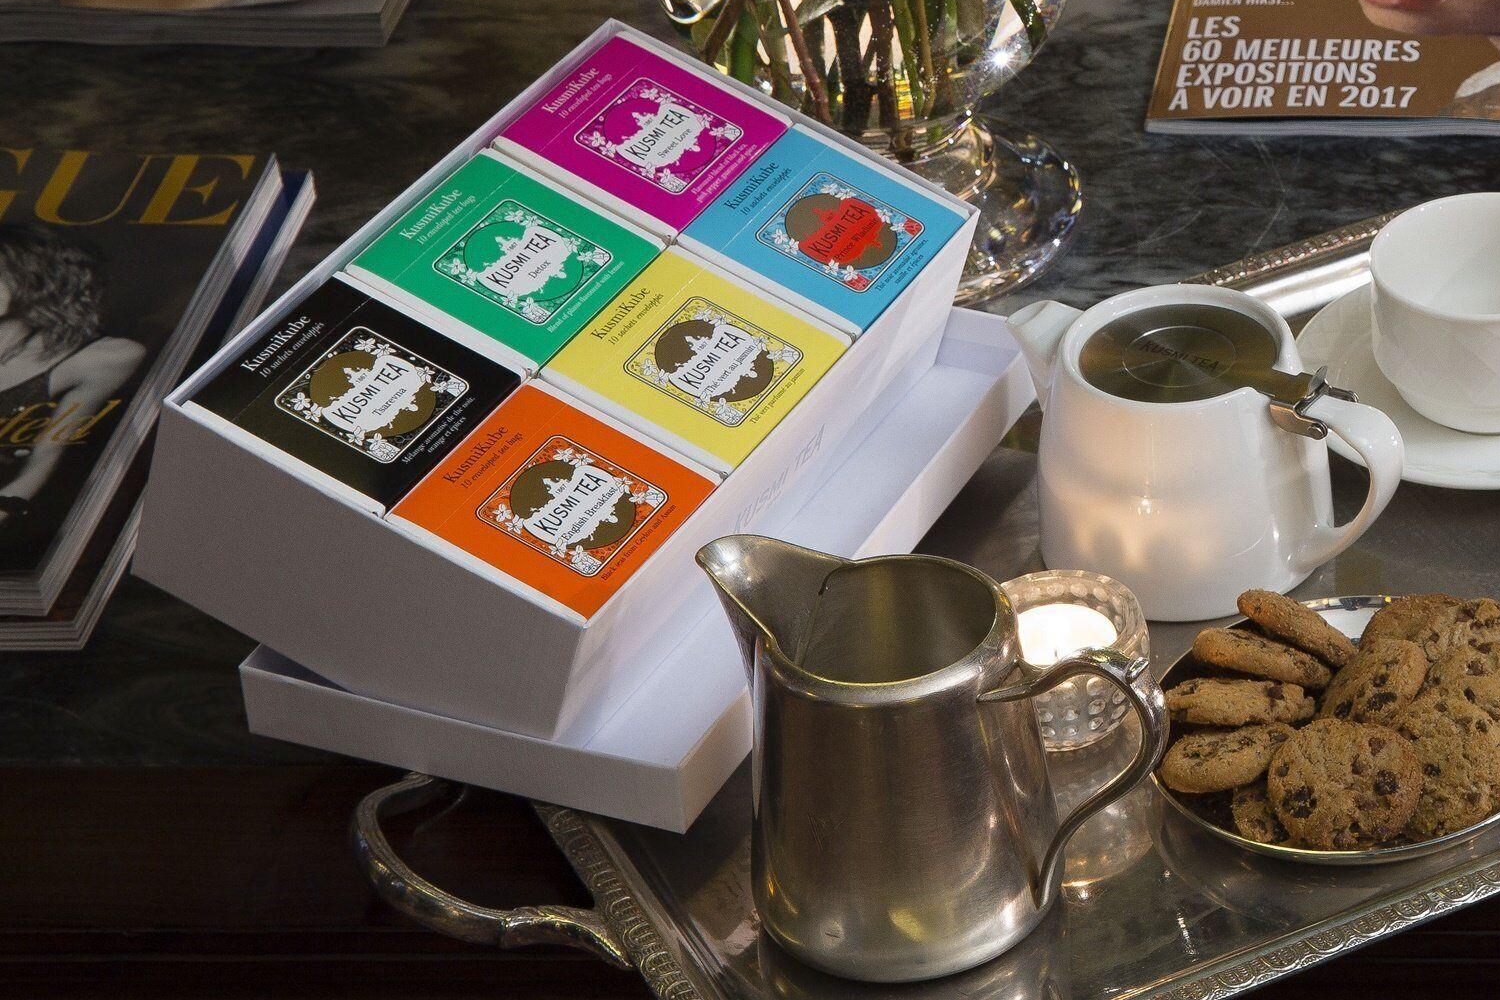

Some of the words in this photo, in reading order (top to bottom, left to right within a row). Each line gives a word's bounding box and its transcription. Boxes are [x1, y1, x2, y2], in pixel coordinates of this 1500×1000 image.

[1182, 39, 1223, 62] 60
[1233, 38, 1421, 62] MEILLEURES
[1186, 15, 1242, 39] LES
[542, 67, 600, 114] KusmiKube
[1176, 61, 1378, 88] EXPOSITIONS
[1203, 86, 1275, 110] VOIR
[1286, 85, 1329, 108] EN
[1339, 85, 1418, 109] 2017
[623, 127, 667, 160] KUSMI
[659, 109, 690, 129] TEA
[656, 140, 679, 158] Sweet
[673, 127, 693, 142] Love
[724, 161, 779, 210] KusmiKube
[738, 205, 751, 215] 10
[398, 189, 463, 239] KusmiKube
[414, 234, 429, 244] 10
[808, 223, 848, 257] KUSMI
[841, 204, 871, 225] TEA
[485, 252, 531, 288] KUSMI
[524, 232, 556, 254] TEA
[527, 259, 552, 278] Detox
[590, 287, 651, 340] KusmiKube
[606, 335, 620, 345] 10
[614, 317, 638, 337] sachets
[632, 292, 666, 320] enveloppés
[239, 316, 314, 372] KusmiKube
[257, 367, 273, 377] 10
[266, 348, 295, 369] sachets
[287, 320, 329, 351] enveloppés
[678, 352, 722, 389] KUSMI
[714, 331, 746, 353] TEA
[703, 380, 720, 393] Thé
[715, 369, 731, 382] vert
[727, 362, 738, 370] au
[733, 343, 759, 365] jasmin
[1140, 340, 1189, 360] KUSMI
[330, 384, 382, 424] KUSMI
[374, 362, 409, 385] TEA
[370, 386, 408, 416] Tsarevna
[748, 413, 762, 424] Thé
[757, 405, 770, 415] vert
[399, 441, 428, 464] Mélange
[444, 414, 456, 422] de
[451, 406, 465, 416] thé
[425, 435, 448, 453] orange
[448, 415, 469, 432] épices
[442, 425, 510, 483] KusmiKube
[459, 478, 473, 488] 10
[467, 452, 503, 482] enveloped
[496, 444, 509, 454] tea
[504, 431, 525, 446] bags
[532, 494, 581, 536] KUSMI
[573, 472, 607, 496] TEA
[560, 514, 591, 541] English
[583, 485, 618, 516] Breakfast
[599, 565, 617, 580] Black
[622, 544, 638, 558] from
[633, 527, 654, 546] Ceylon
[649, 518, 663, 529] and
